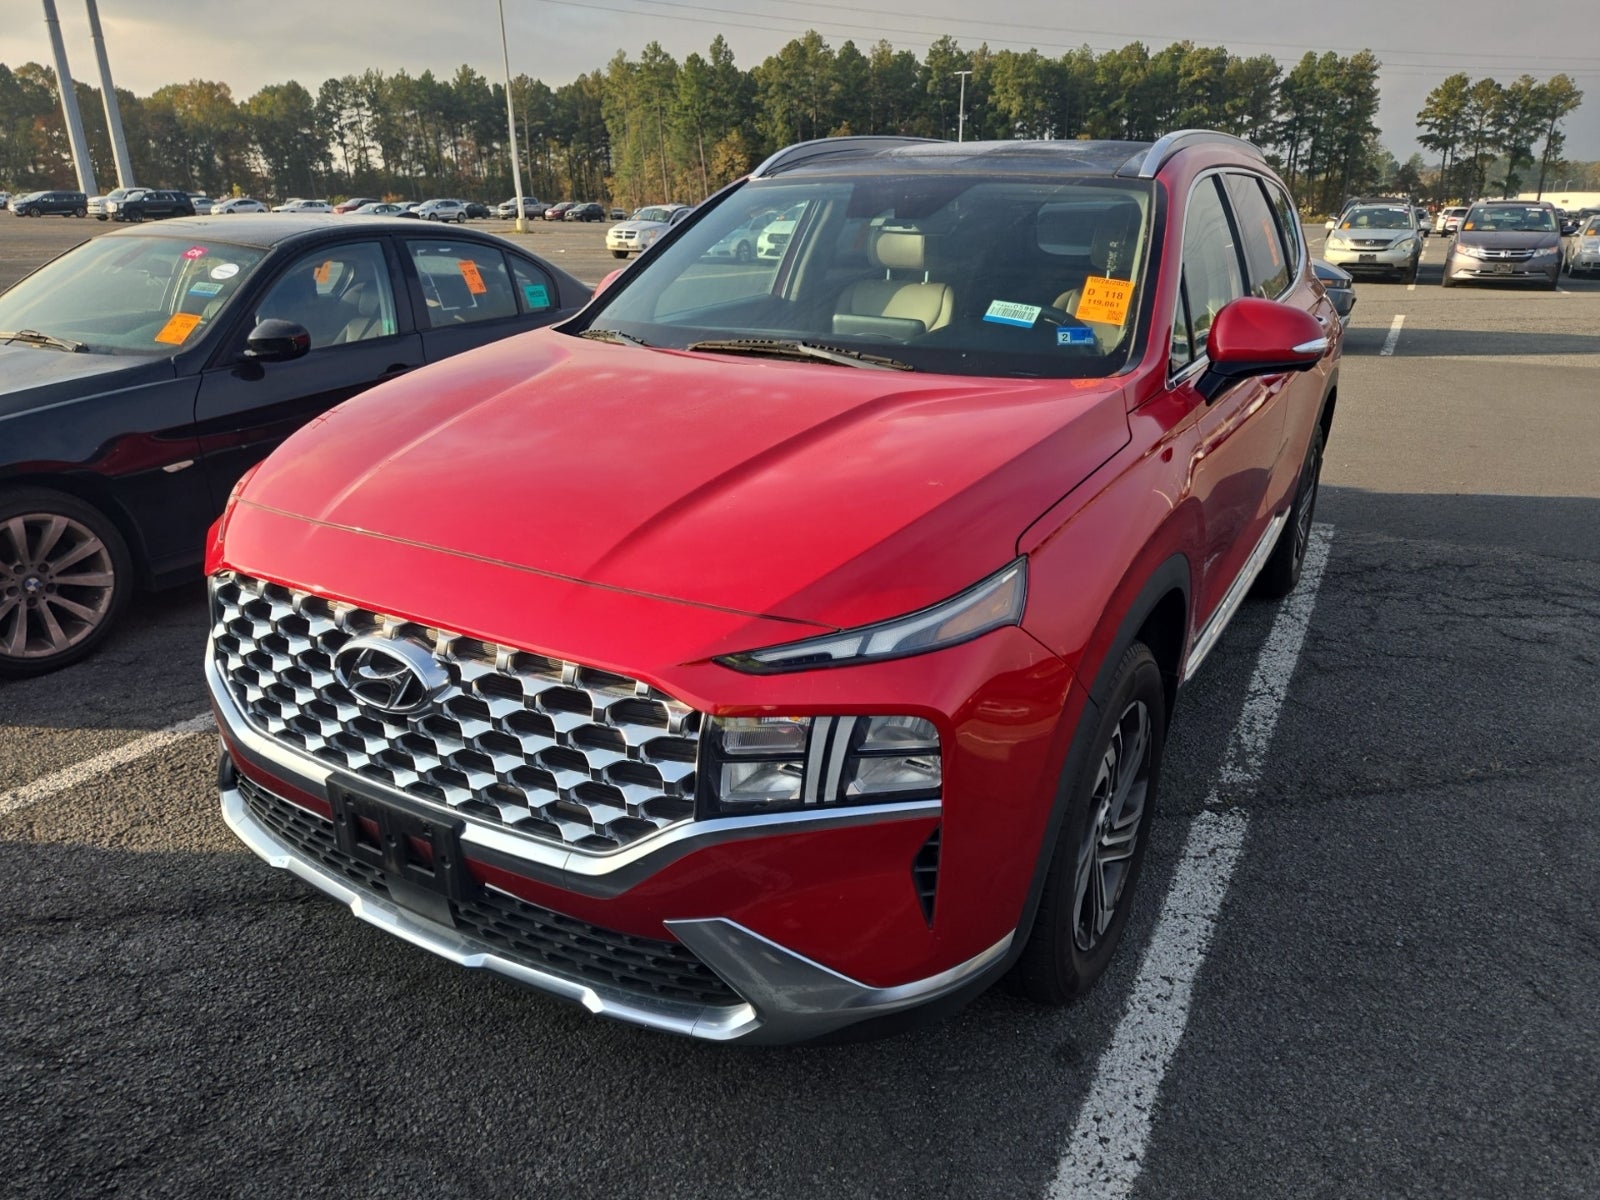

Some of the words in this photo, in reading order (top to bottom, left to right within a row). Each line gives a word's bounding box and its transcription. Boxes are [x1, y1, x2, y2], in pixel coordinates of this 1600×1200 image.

[1087, 288, 1096, 296] D
[1104, 290, 1124, 301] 118
[1062, 333, 1068, 342] 2
